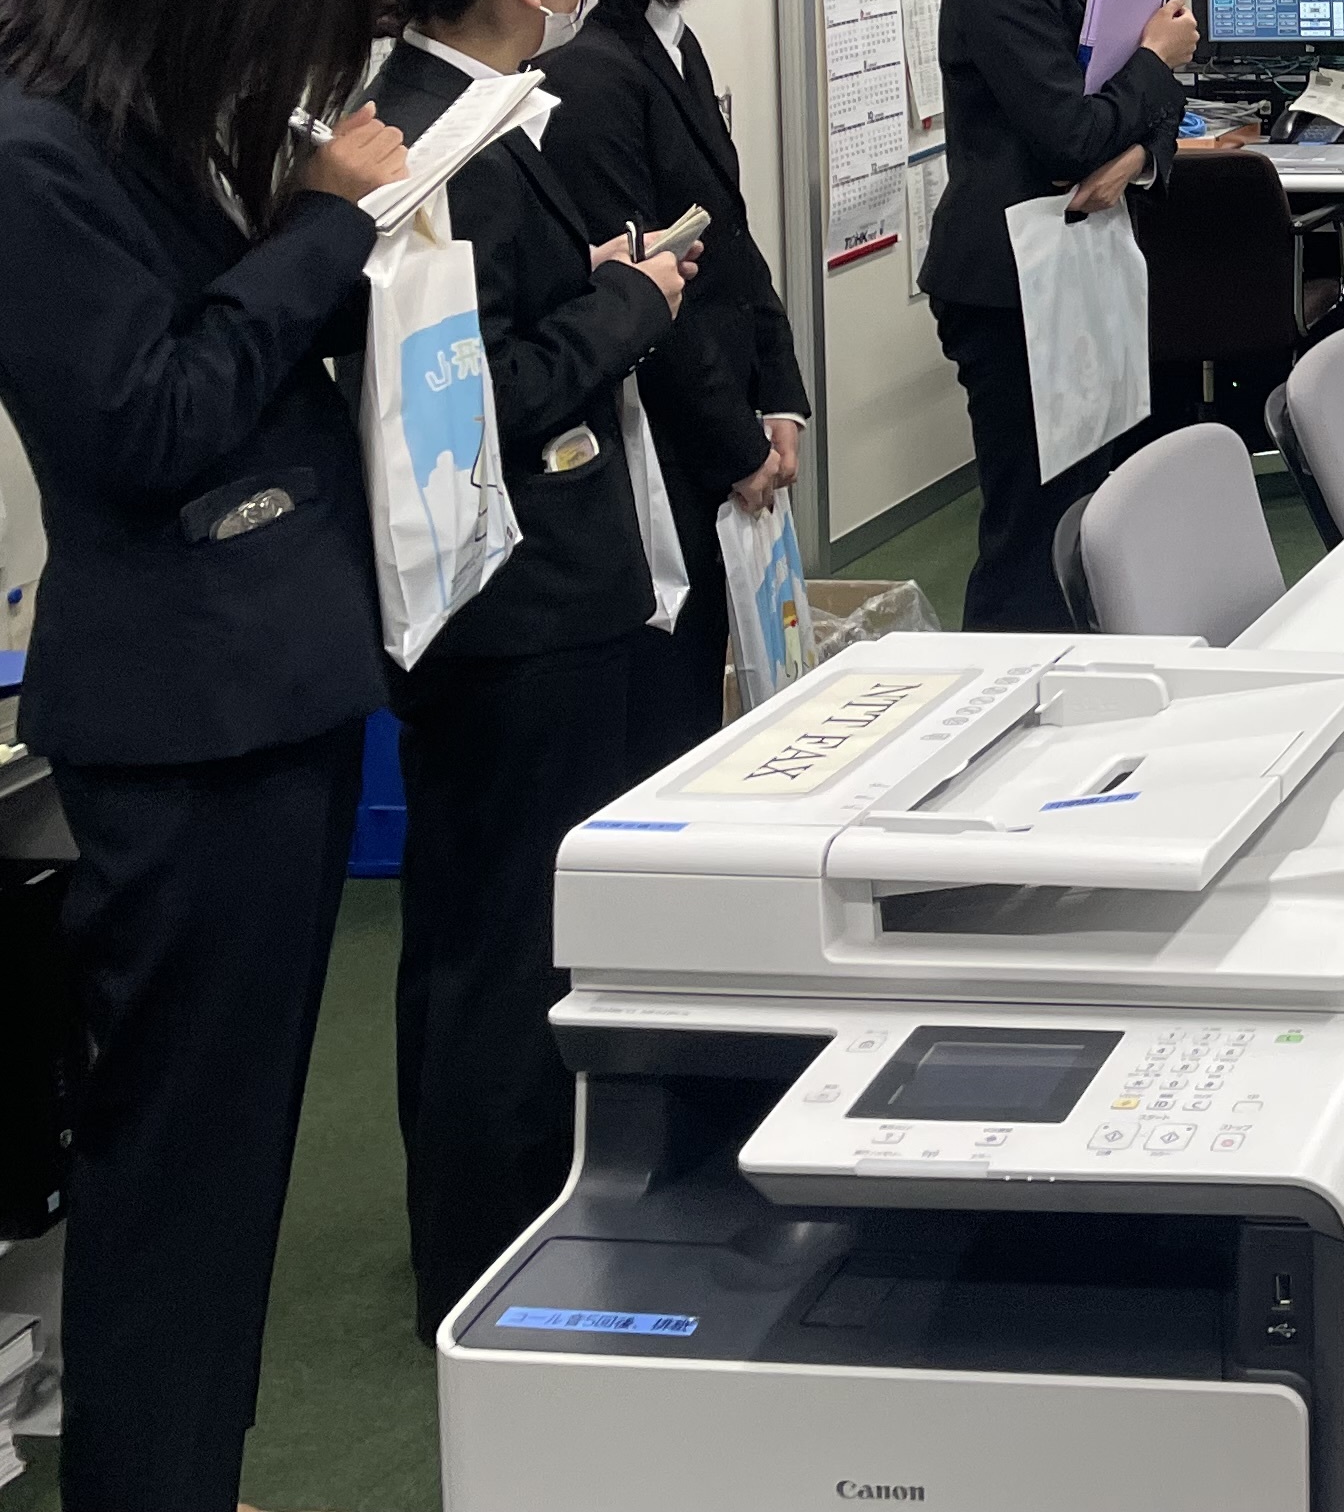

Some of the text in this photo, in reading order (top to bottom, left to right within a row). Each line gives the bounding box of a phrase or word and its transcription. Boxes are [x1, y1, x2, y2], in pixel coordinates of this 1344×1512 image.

[742, 683, 923, 781] NTT FAX
[836, 1480, 925, 1501] Canon
